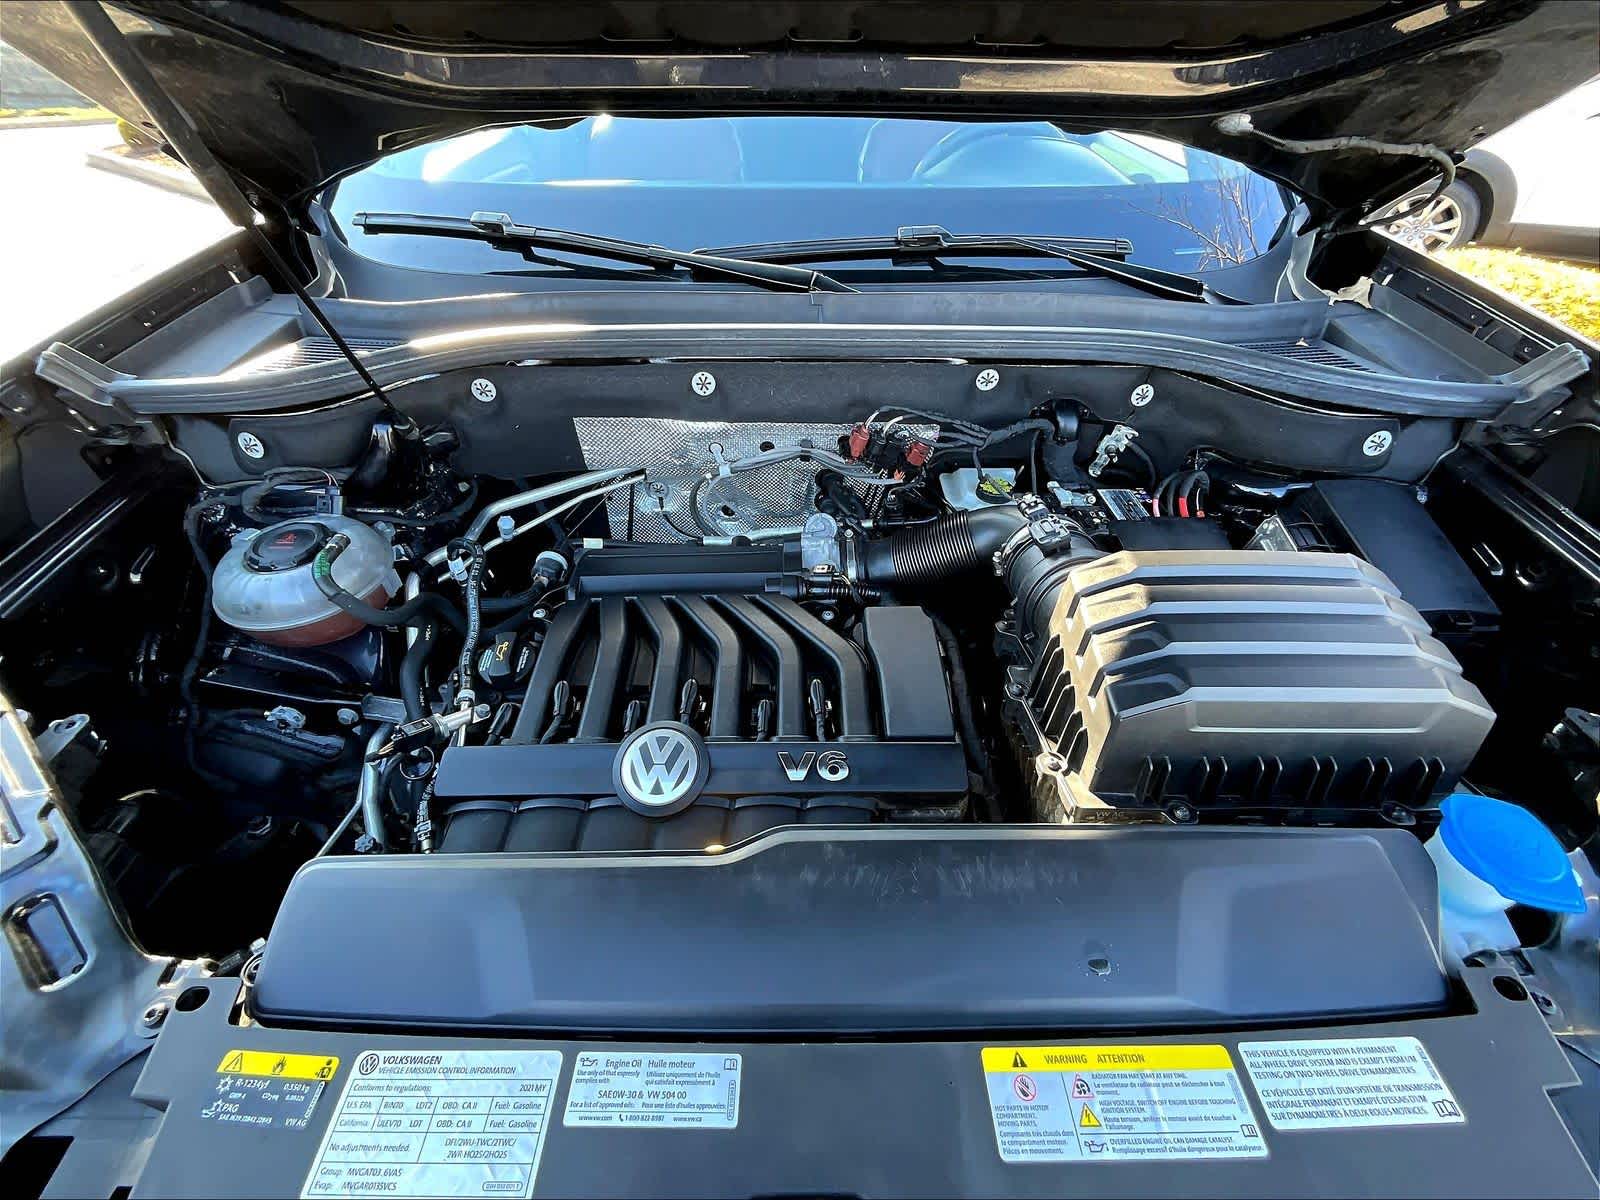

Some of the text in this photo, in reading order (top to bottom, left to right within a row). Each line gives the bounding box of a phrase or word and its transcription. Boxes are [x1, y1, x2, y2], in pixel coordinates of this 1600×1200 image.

[777, 751, 849, 781] V6
[1243, 1050, 1260, 1058] THIS
[1260, 1049, 1290, 1058] VEHICLE
[1289, 1049, 1297, 1057] IS
[1297, 1048, 1331, 1058] EQUIPPED
[1331, 1047, 1351, 1056] WITH
[1357, 1045, 1397, 1055] PERMANENT
[383, 1055, 442, 1065] VOLKSWAGEN
[1045, 1053, 1146, 1064] WARNING ATTENTION
[1250, 1060, 1288, 1069] ALL-WHEEL
[1288, 1059, 1310, 1068] DRIVE
[1310, 1058, 1335, 1067] SYSTEM
[1335, 1057, 1352, 1066] AND
[1351, 1057, 1359, 1065] IS
[1359, 1056, 1383, 1065] EXEMPT
[1383, 1056, 1404, 1064] FROM
[605, 1059, 696, 1070] Engine Oil Huile moteur
[379, 1066, 516, 1075] VEHICLE EMISSION CONTROL INFORMATION
[1253, 1071, 1283, 1080] TESTING
[1283, 1070, 1296, 1079] ON
[1295, 1069, 1340, 1079] TWO-WHEEL
[1339, 1068, 1361, 1077] DRIVE
[353, 1083, 384, 1092] Conforms
[385, 1083, 393, 1092] to
[393, 1083, 432, 1094] regulations:
[1261, 1089, 1271, 1098] CE
[1392, 1083, 1443, 1092] TRANSMISSION
[647, 1090, 661, 1099] VW
[661, 1091, 676, 1100] 504
[676, 1091, 687, 1100] 00
[494, 1101, 511, 1110] Fuel:
[512, 1101, 541, 1110] Gasoline
[409, 1119, 424, 1128] LDT
[489, 1119, 506, 1128] Fuel:
[508, 1119, 537, 1128] Gasoline
[329, 1143, 340, 1152] No
[340, 1143, 382, 1153] adjustments
